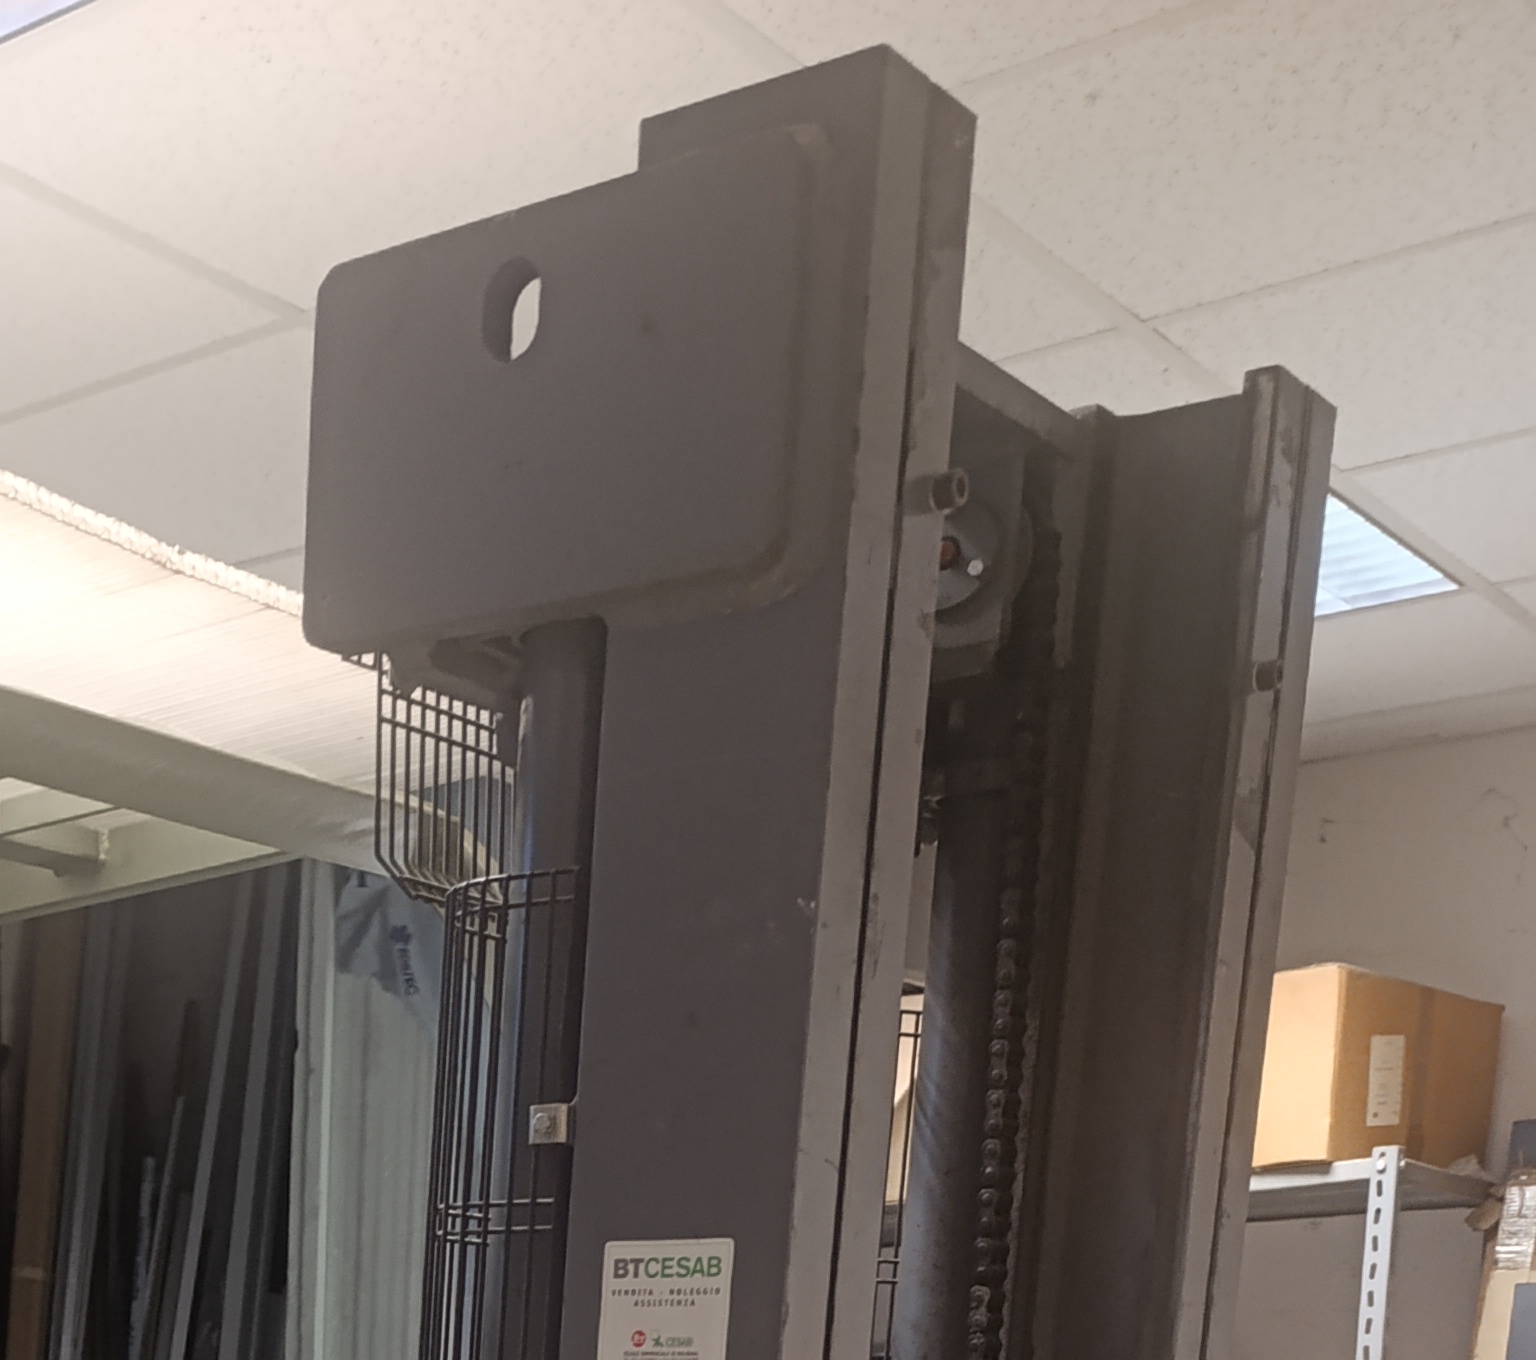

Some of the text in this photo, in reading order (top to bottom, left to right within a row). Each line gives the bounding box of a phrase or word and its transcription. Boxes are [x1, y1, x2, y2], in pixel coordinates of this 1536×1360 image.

[612, 1255, 722, 1279] BTCESAB
[611, 1288, 654, 1297] VENDITA
[669, 1287, 721, 1296] NOLEGGIO
[633, 1299, 696, 1307] ASSISTENZA
